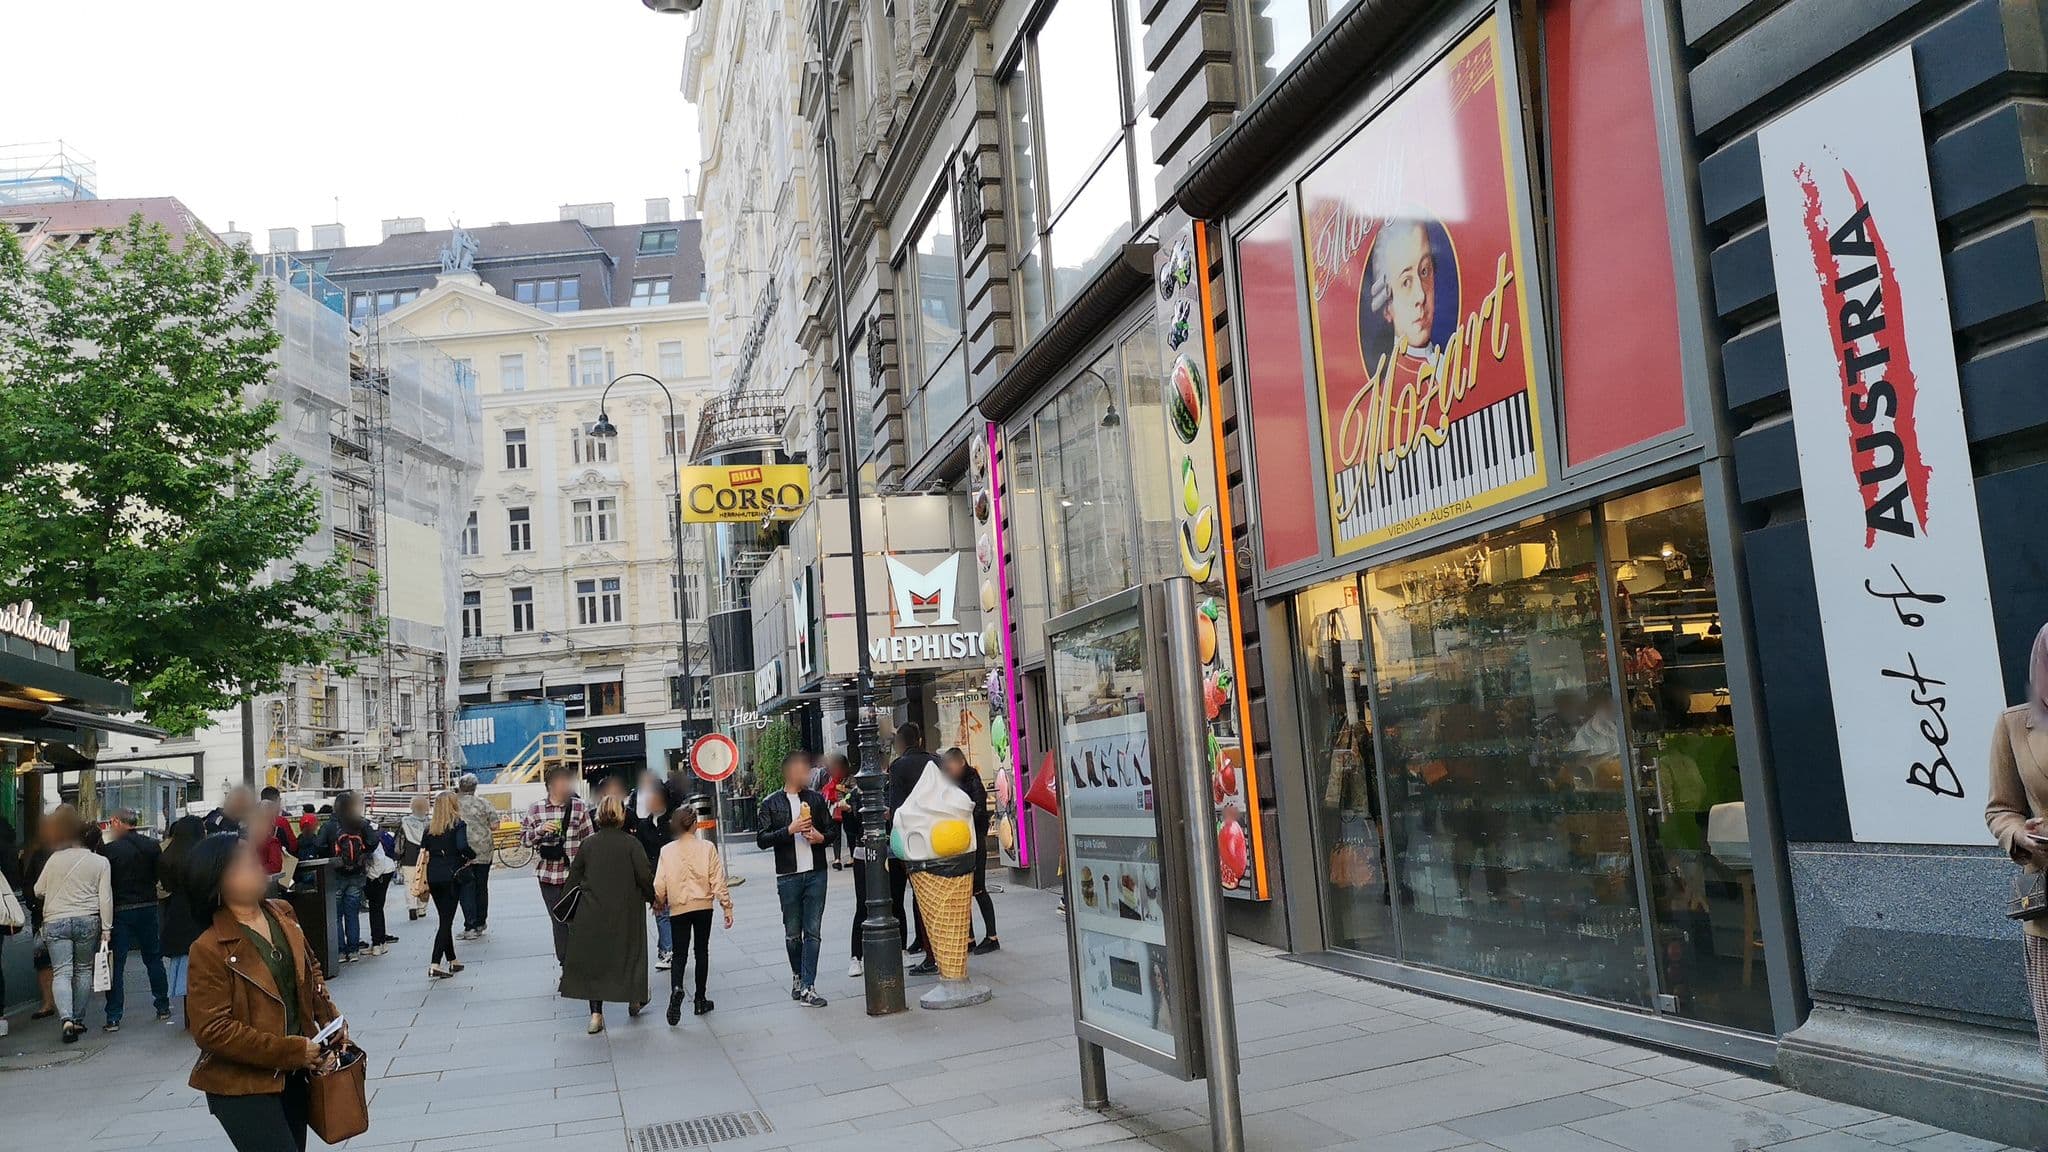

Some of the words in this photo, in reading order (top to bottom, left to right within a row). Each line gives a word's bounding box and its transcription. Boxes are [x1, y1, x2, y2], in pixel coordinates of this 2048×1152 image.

[1335, 251, 1514, 523] Mozart
[1829, 202, 1915, 538] AUSTRIA
[731, 469, 760, 483] BILLA
[1387, 517, 1421, 537] VIENNA
[1430, 501, 1473, 523] AUSTRIA
[1864, 563, 1946, 627] of
[598, 736, 614, 744] CBD
[615, 734, 640, 743] STORE
[1881, 651, 1965, 798] Best
